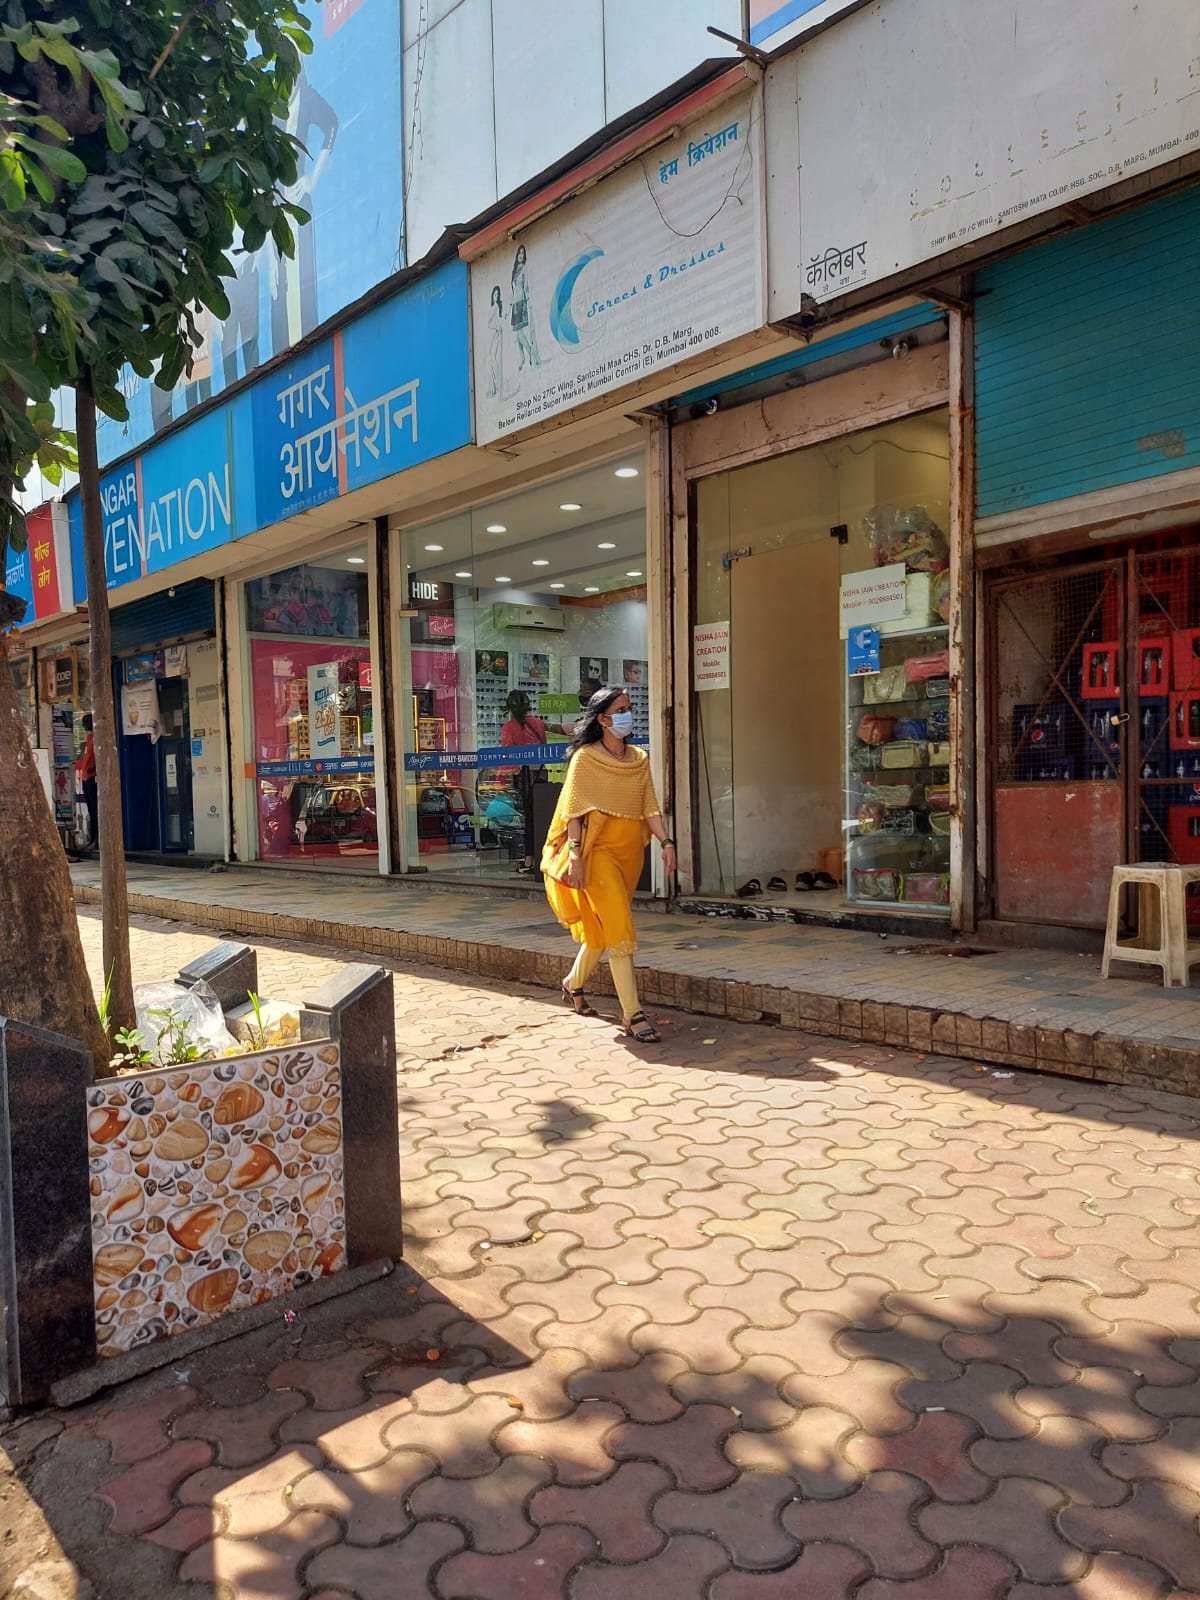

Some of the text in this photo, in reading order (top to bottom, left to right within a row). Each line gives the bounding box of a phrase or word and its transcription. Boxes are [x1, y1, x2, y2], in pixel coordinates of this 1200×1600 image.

[659, 122, 739, 184] हेम क्रियेशन
[931, 236, 946, 248] SHOP
[976, 215, 993, 228] WING
[997, 199, 1029, 218] SANTOSHI
[1030, 193, 1047, 206] MATA
[1123, 152, 1147, 167] MARG,
[1184, 129, 1200, 142] 400
[587, 241, 726, 318] Sarees & Dresses
[806, 241, 867, 287] कॅलिबर
[498, 416, 516, 430] Below
[516, 405, 541, 422] Reliance
[542, 397, 561, 411] Super
[562, 385, 586, 401] Market,
[587, 373, 614, 391] Mumbai
[615, 362, 641, 378] Central
[656, 341, 687, 361] Mumbai
[688, 333, 703, 346] 400
[516, 398, 532, 411] Shop
[532, 394, 541, 403] No
[576, 364, 606, 384] Santoshi
[607, 358, 622, 370] Maa
[654, 335, 671, 349] D.B.
[277, 364, 331, 429] गंगर
[280, 378, 420, 498] आयनेशन
[100, 472, 137, 517] NGAR
[104, 463, 231, 577] YENATION
[34, 540, 50, 562] गोल्ड
[38, 565, 51, 588] लोन
[412, 582, 439, 600] HIDE
[695, 633, 713, 642] NISHA
[696, 644, 727, 656] CREATION
[439, 754, 478, 763] HARLEY-DAVIDSO
[537, 746, 560, 759] ELLE
